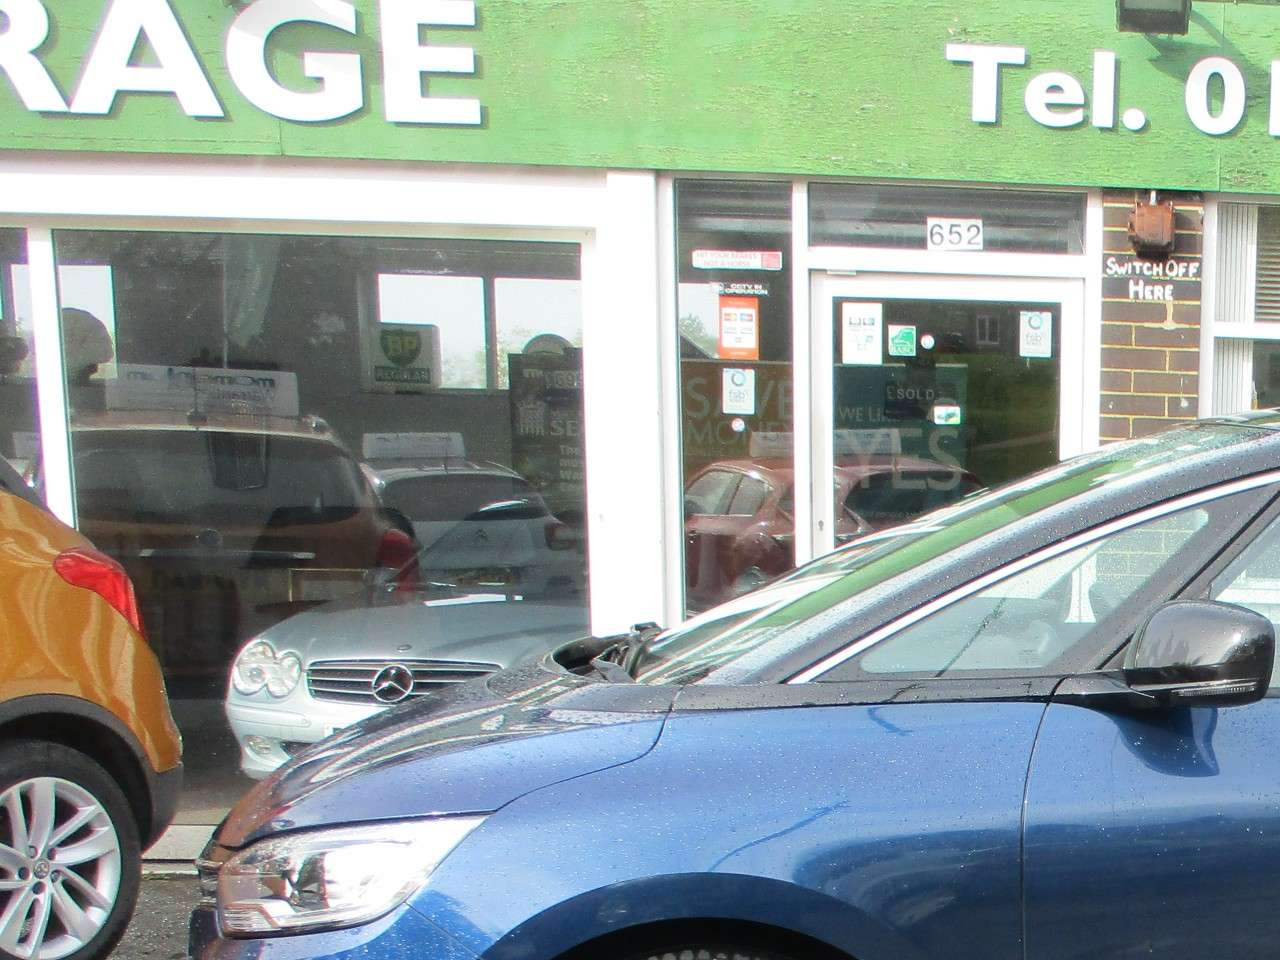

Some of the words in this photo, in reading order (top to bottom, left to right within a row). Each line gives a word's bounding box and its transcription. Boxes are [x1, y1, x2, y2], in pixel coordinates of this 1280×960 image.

[945, 43, 1146, 132] Tel.
[929, 223, 981, 246] 652
[1166, 260, 1200, 278] OFF
[388, 337, 417, 354] BP
